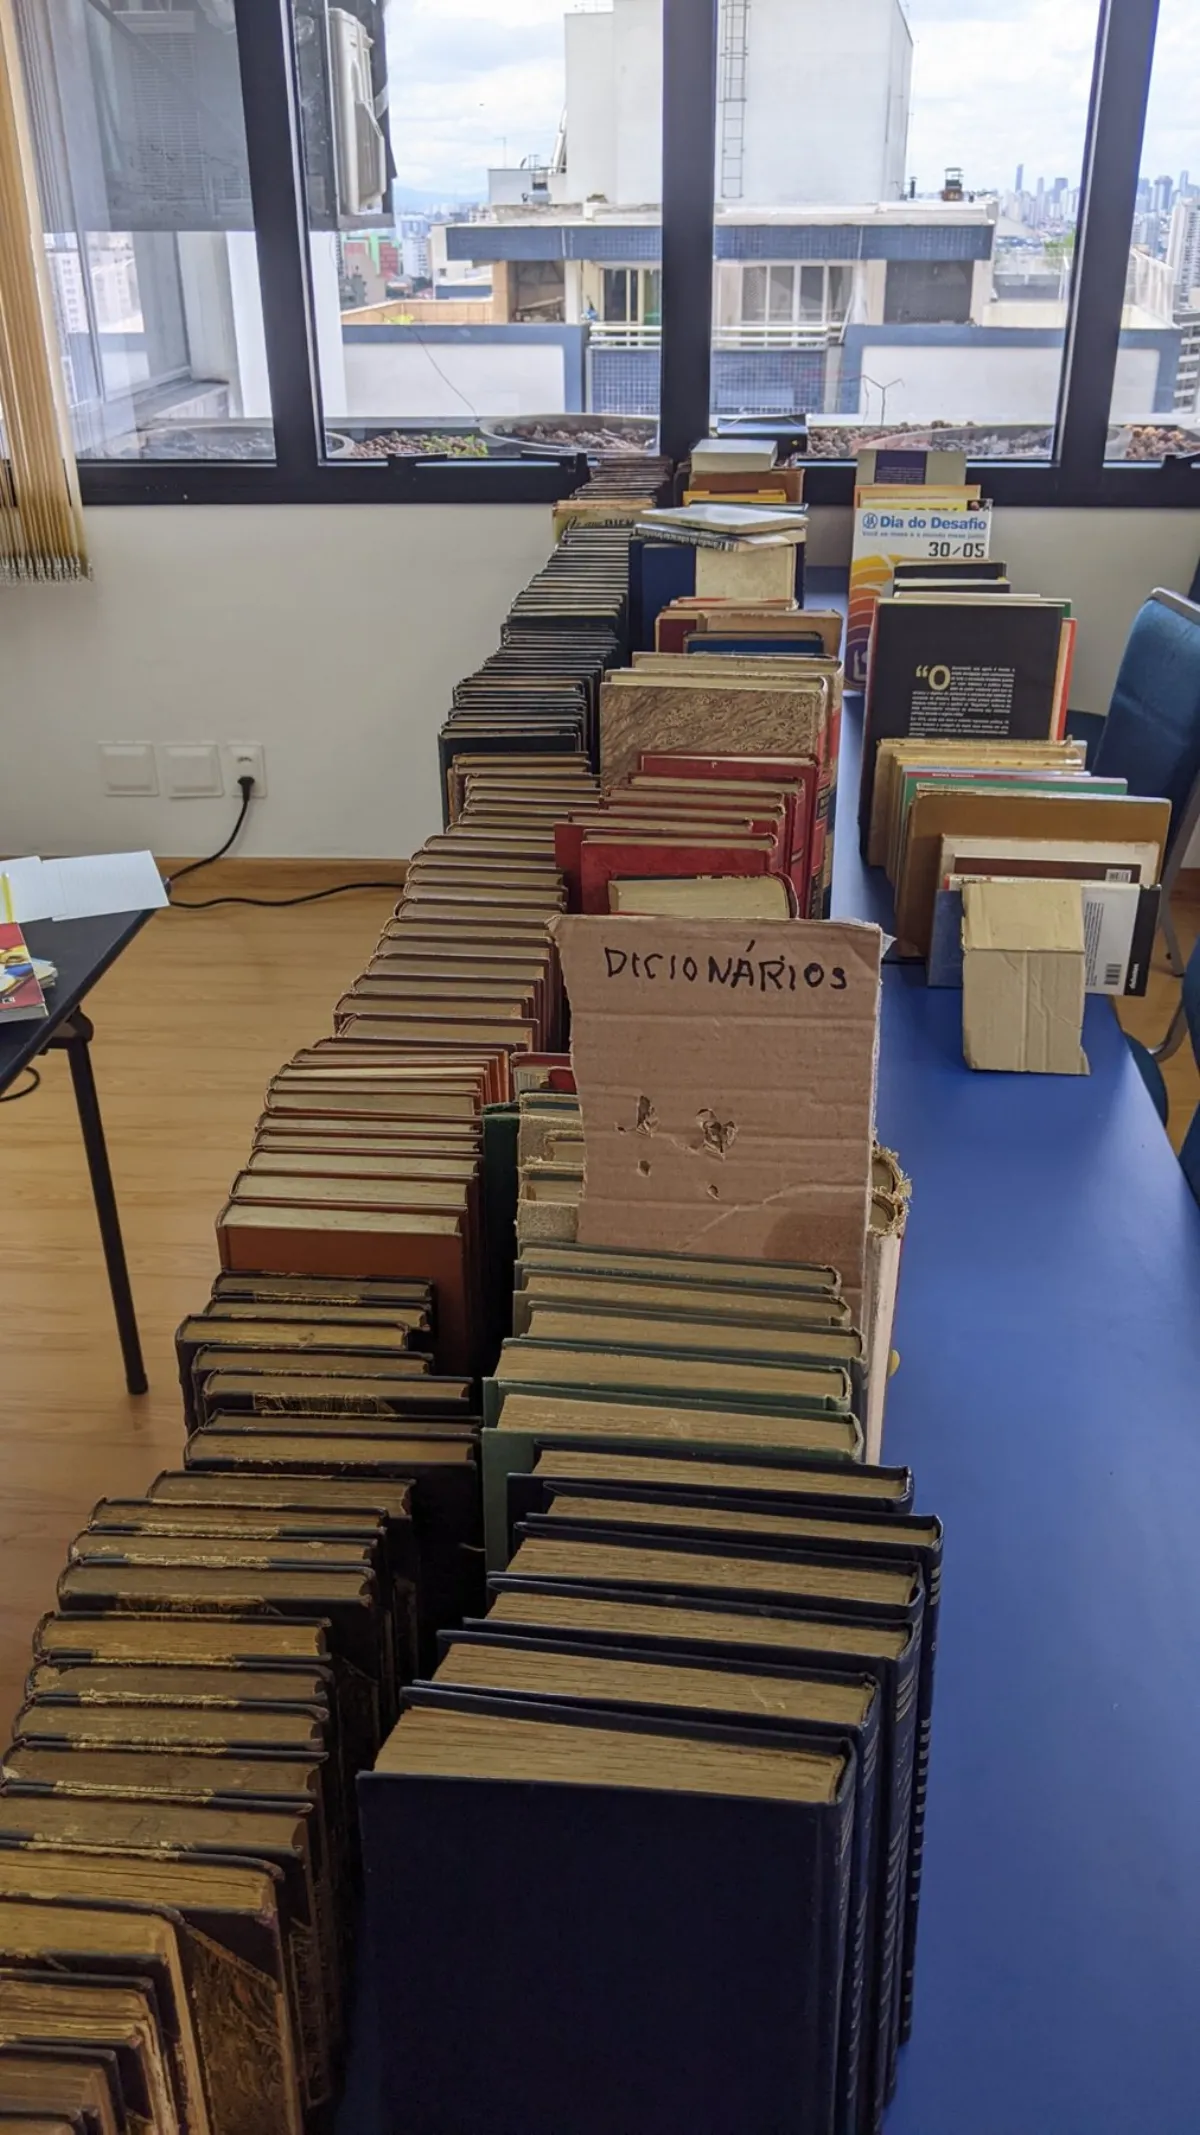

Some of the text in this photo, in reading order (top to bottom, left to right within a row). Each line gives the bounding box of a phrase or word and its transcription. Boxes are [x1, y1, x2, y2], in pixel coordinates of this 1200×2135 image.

[880, 515, 987, 530] Dia do Desafio
[928, 541, 985, 558] 30/05
[604, 940, 848, 991] DICIONÁRIOS
